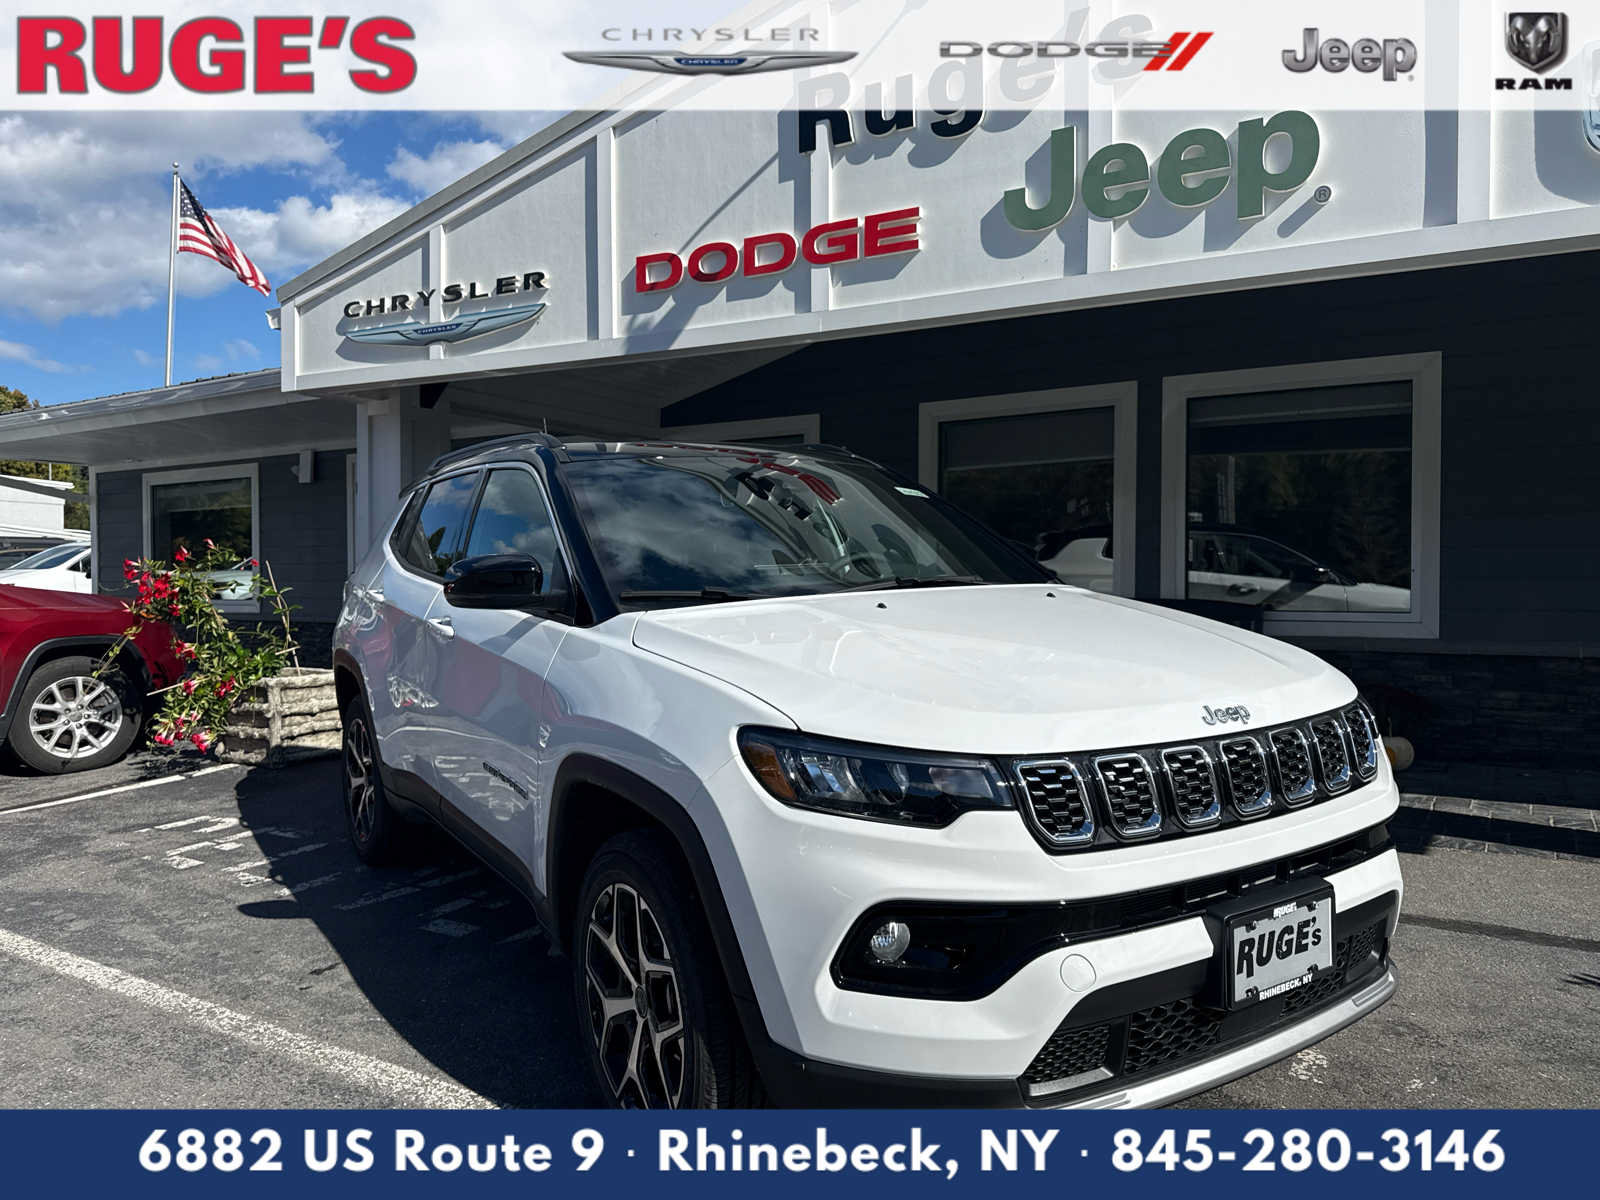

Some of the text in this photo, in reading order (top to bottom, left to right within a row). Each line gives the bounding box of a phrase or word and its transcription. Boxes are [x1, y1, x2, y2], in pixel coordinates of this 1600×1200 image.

[1003, 110, 1320, 232] Jeep
[635, 206, 920, 293] DODGE
[343, 270, 547, 319] CHRYSLER
[1201, 704, 1251, 726] Jeep
[1302, 973, 1314, 985] NY
